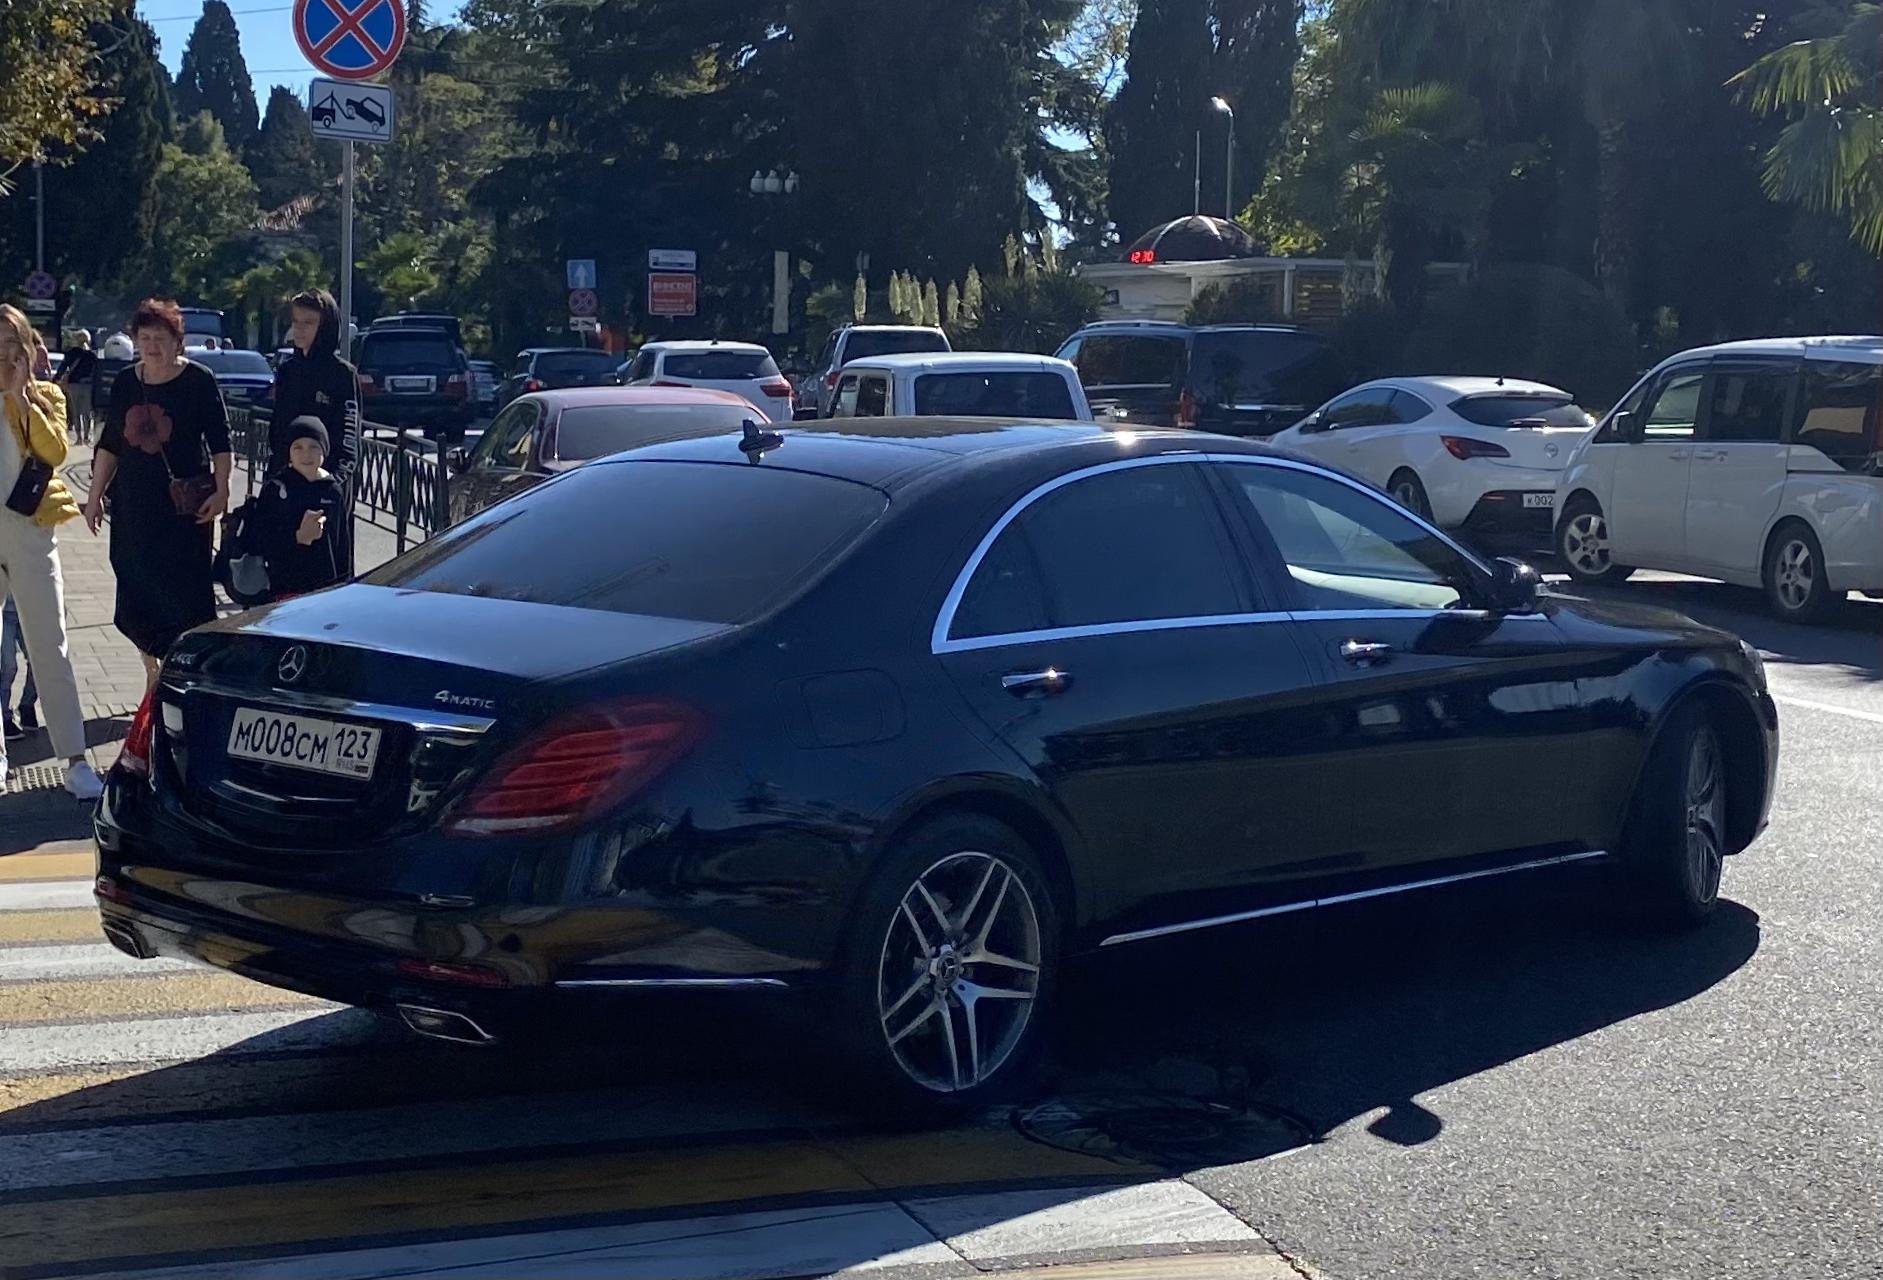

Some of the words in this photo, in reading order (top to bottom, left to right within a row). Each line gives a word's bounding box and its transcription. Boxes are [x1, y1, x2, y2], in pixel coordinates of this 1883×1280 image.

[434, 689, 495, 709] 4MATIC
[234, 717, 329, 764] М008СМ
[335, 727, 372, 760] 123
